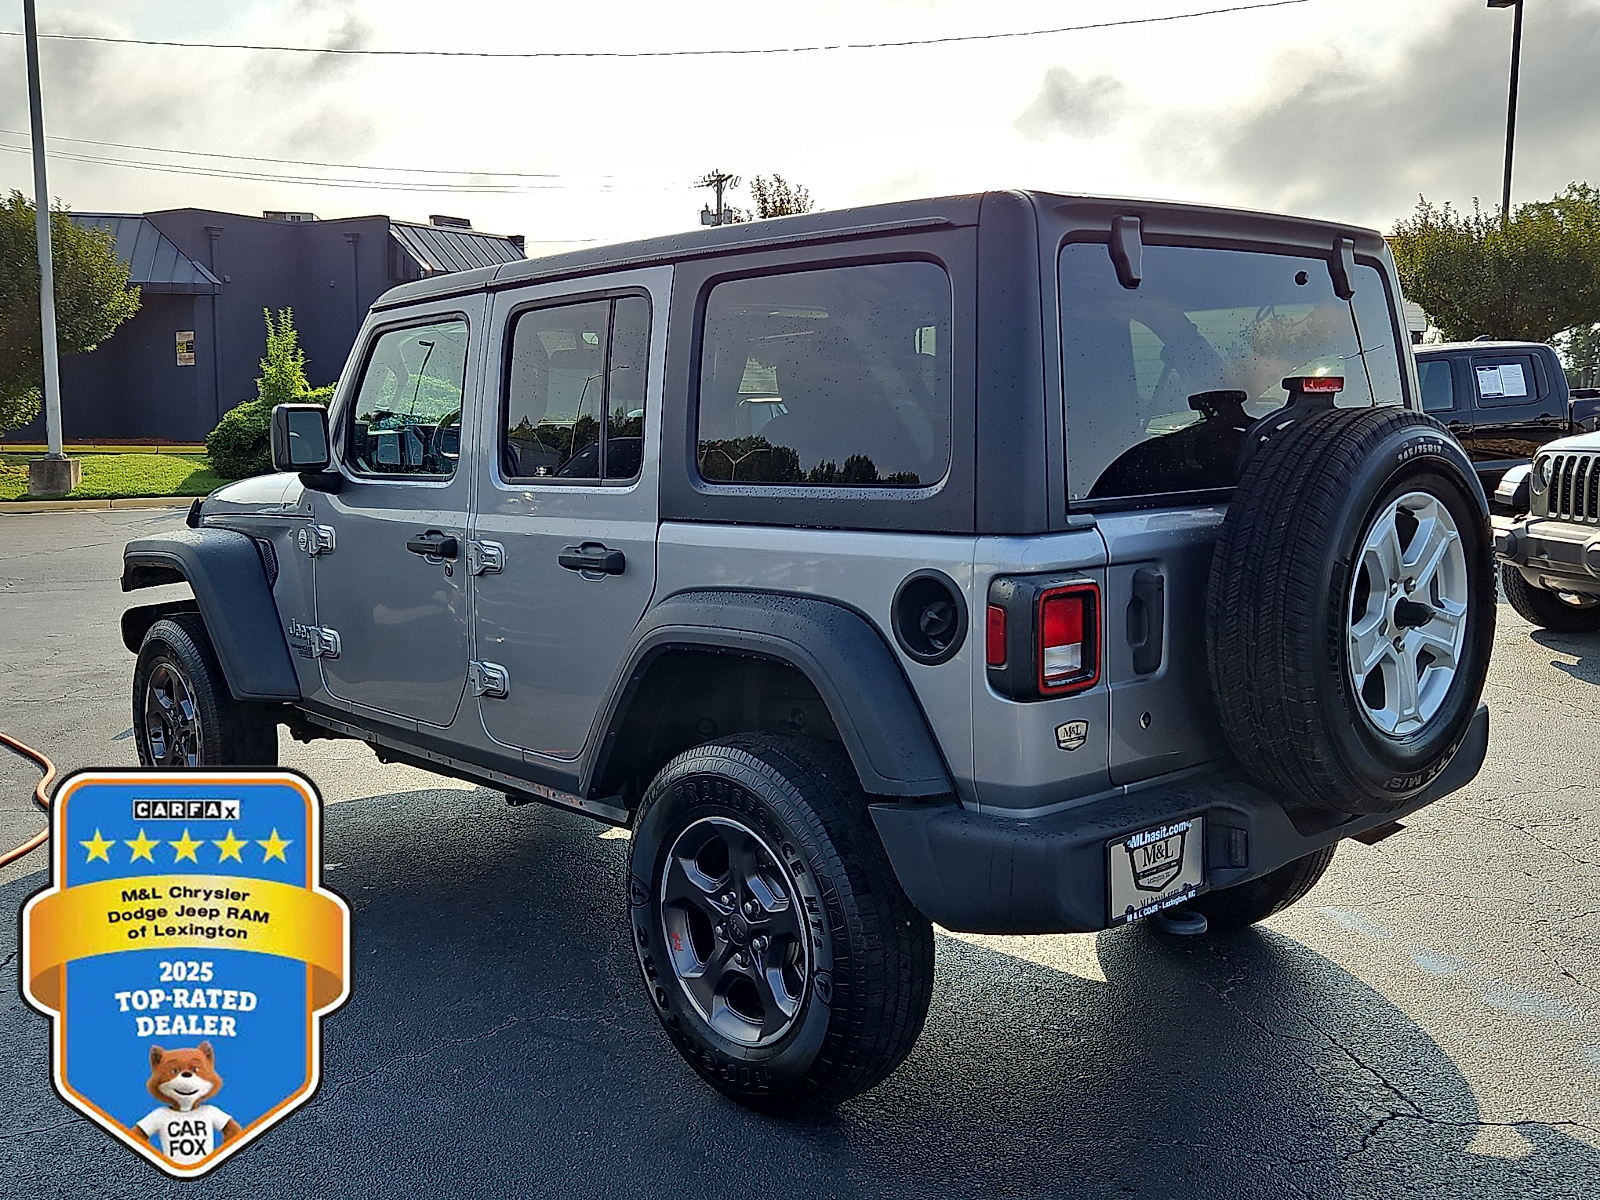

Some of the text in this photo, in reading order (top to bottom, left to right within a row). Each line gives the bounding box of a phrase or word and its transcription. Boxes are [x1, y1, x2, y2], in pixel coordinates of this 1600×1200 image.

[674, 780, 805, 877] TRANSFORCE
[1131, 821, 1186, 848] MLhasit.com
[1143, 839, 1174, 867] M&L
